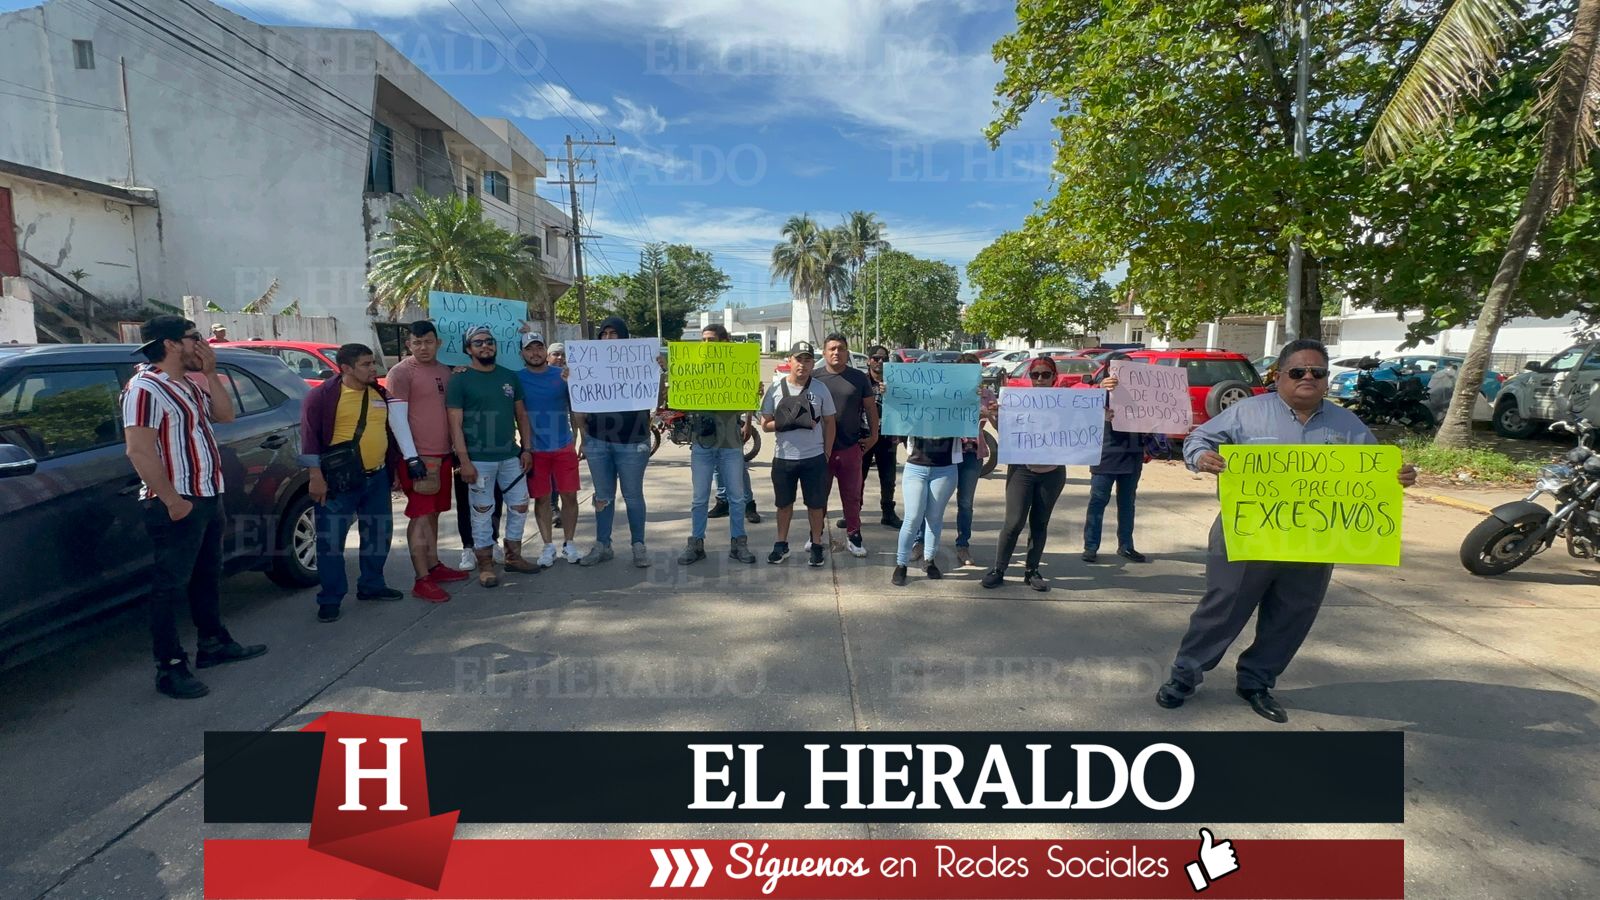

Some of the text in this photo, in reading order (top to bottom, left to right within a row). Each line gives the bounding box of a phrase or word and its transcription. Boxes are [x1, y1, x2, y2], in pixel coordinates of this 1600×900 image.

[443, 296, 468, 313] NO
[606, 345, 654, 364] BASTA
[698, 345, 736, 360] GENTE
[575, 364, 654, 381] DE TANTA
[669, 361, 726, 377] CORRUPTA
[672, 376, 756, 393] ACABANDO CON
[943, 388, 963, 400] LA
[1130, 388, 1178, 407] DE LOS
[1016, 412, 1037, 425] EL
[1227, 450, 1389, 474] CANSADOS DE
[1241, 478, 1377, 500] LOS PRECIOS
[1234, 499, 1395, 537] EXCESIVOS
